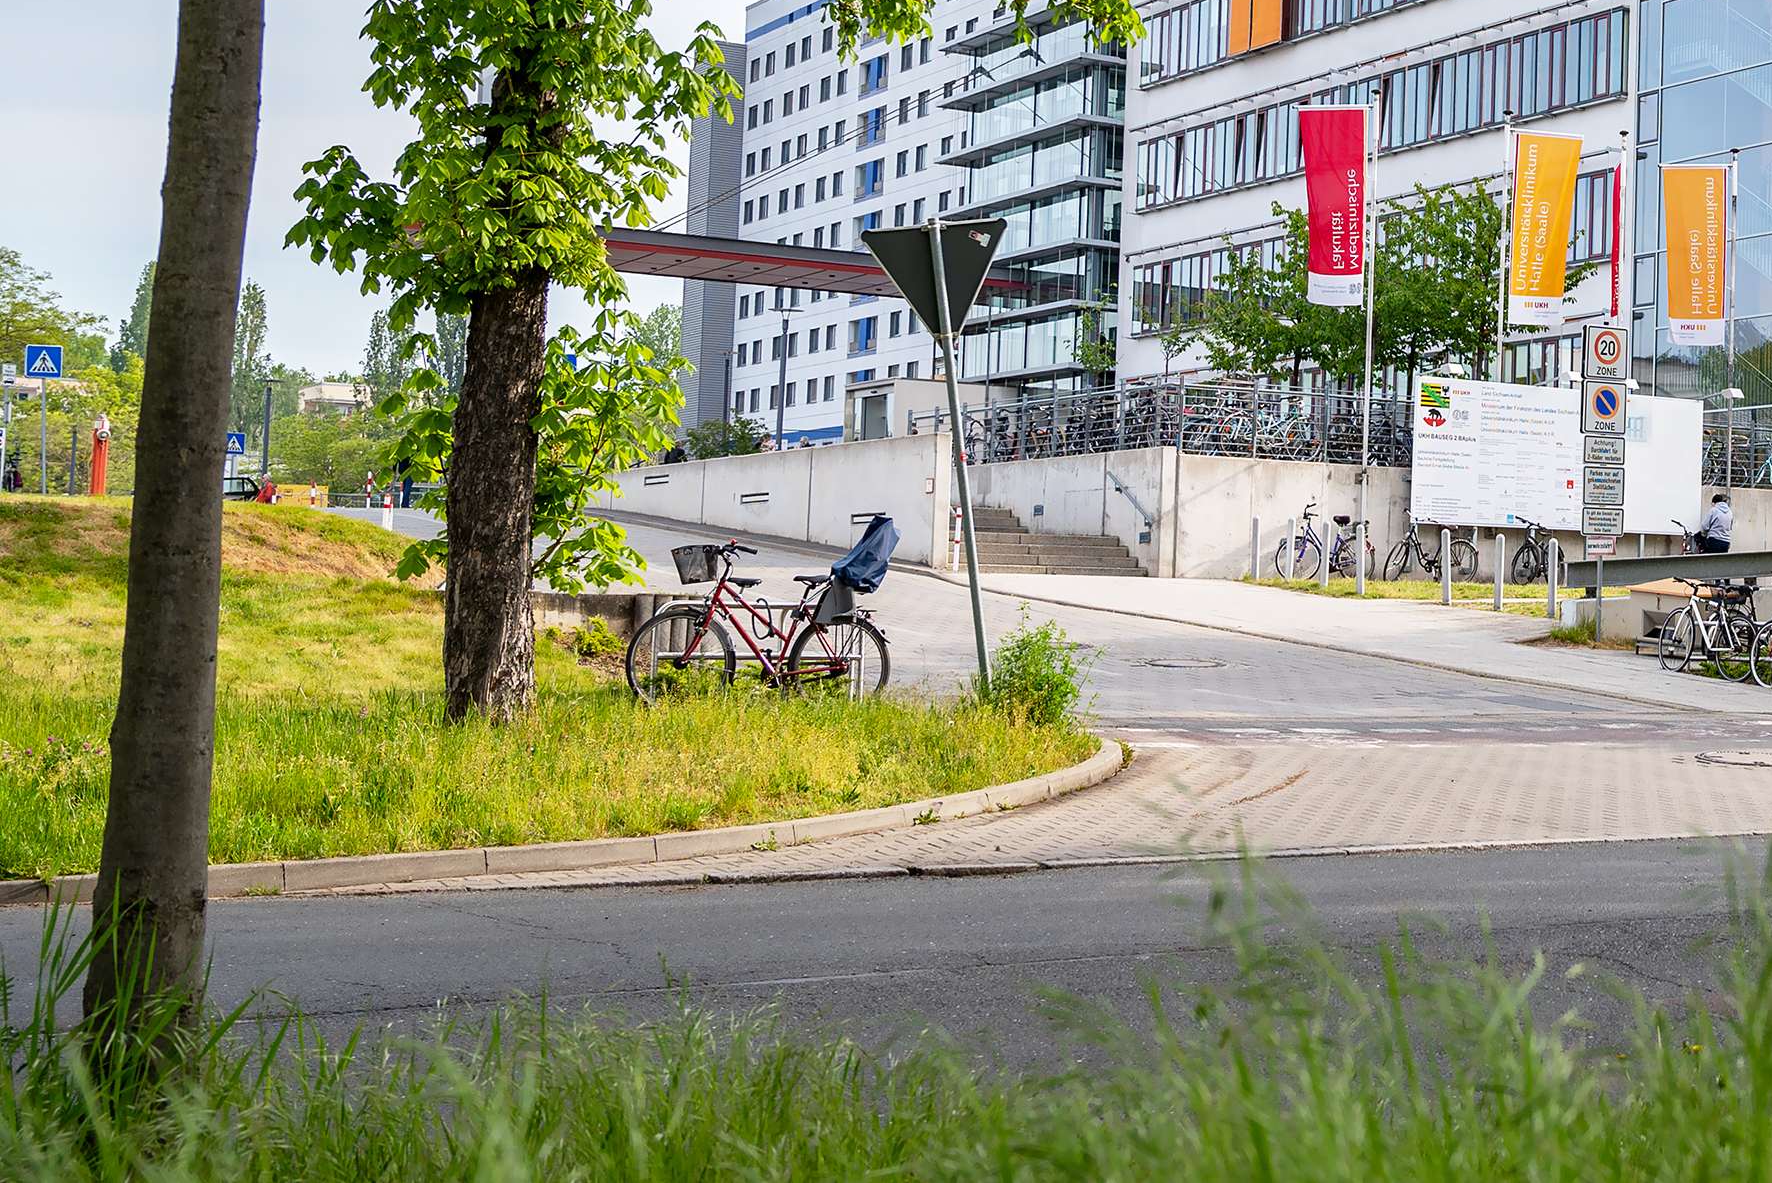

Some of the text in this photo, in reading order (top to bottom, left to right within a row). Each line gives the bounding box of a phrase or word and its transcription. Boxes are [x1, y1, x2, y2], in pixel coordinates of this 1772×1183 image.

[1516, 144, 1538, 290] Universitätsklinikum
[1530, 201, 1551, 291] Halle (Saale)
[1600, 340, 1615, 356] 20
[1597, 366, 1617, 376] ZONE
[1594, 421, 1615, 431] ZONE
[1594, 439, 1616, 447] Achtung!
